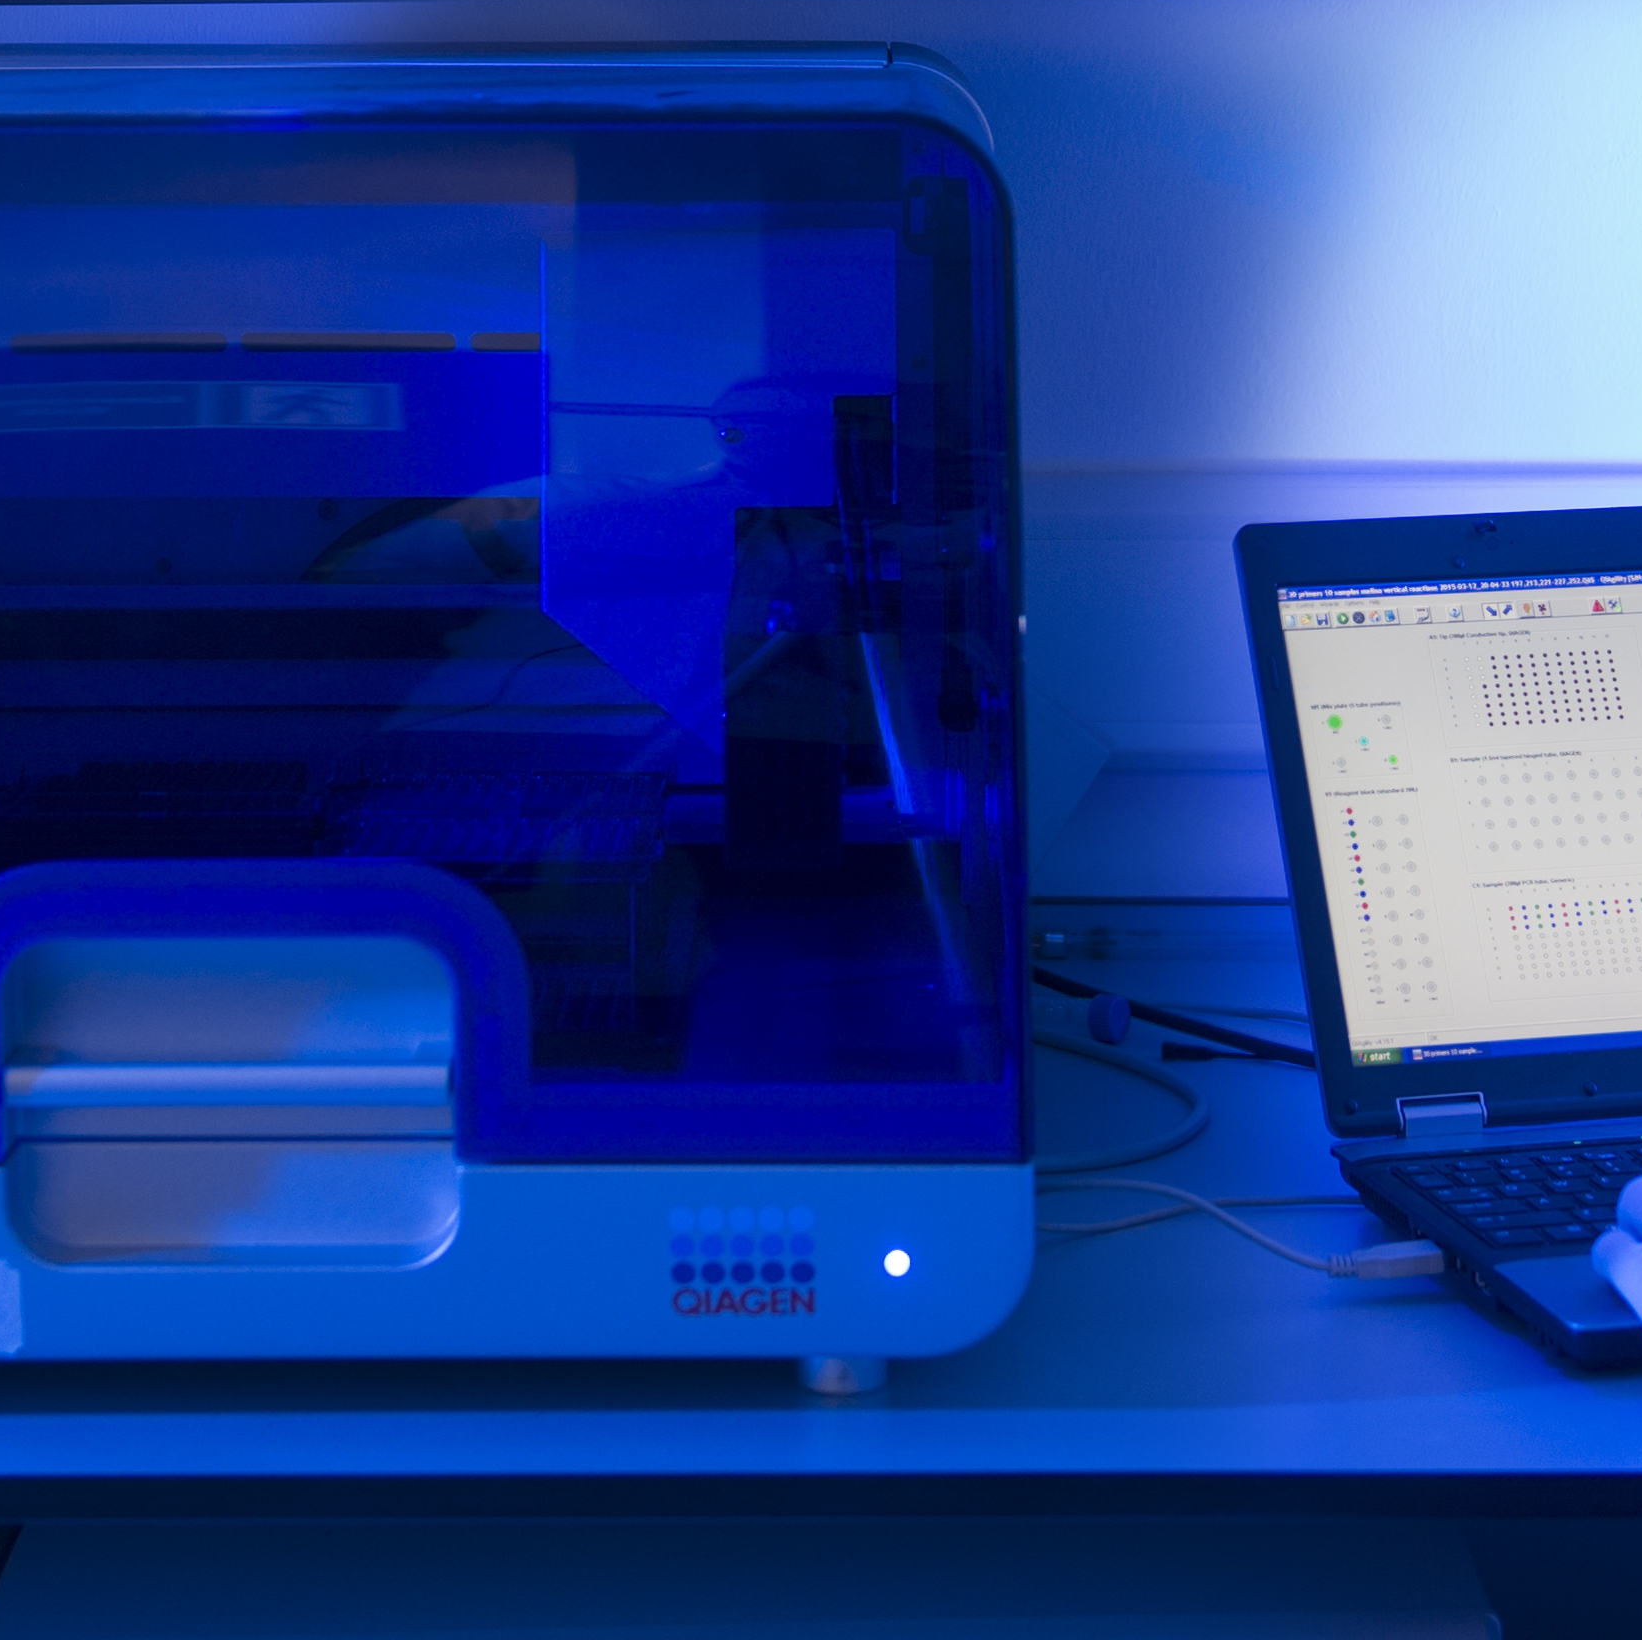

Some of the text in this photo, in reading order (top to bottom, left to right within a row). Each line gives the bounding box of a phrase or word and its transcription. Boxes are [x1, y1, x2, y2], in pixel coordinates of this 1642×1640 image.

[1298, 590, 1323, 600] primers
[1324, 589, 1333, 598] 10
[1334, 588, 1360, 598] samples
[1383, 586, 1408, 595] vertical
[1409, 584, 1439, 593] reactions
[1369, 1052, 1391, 1062] start
[671, 1286, 817, 1317] QIAGEN
